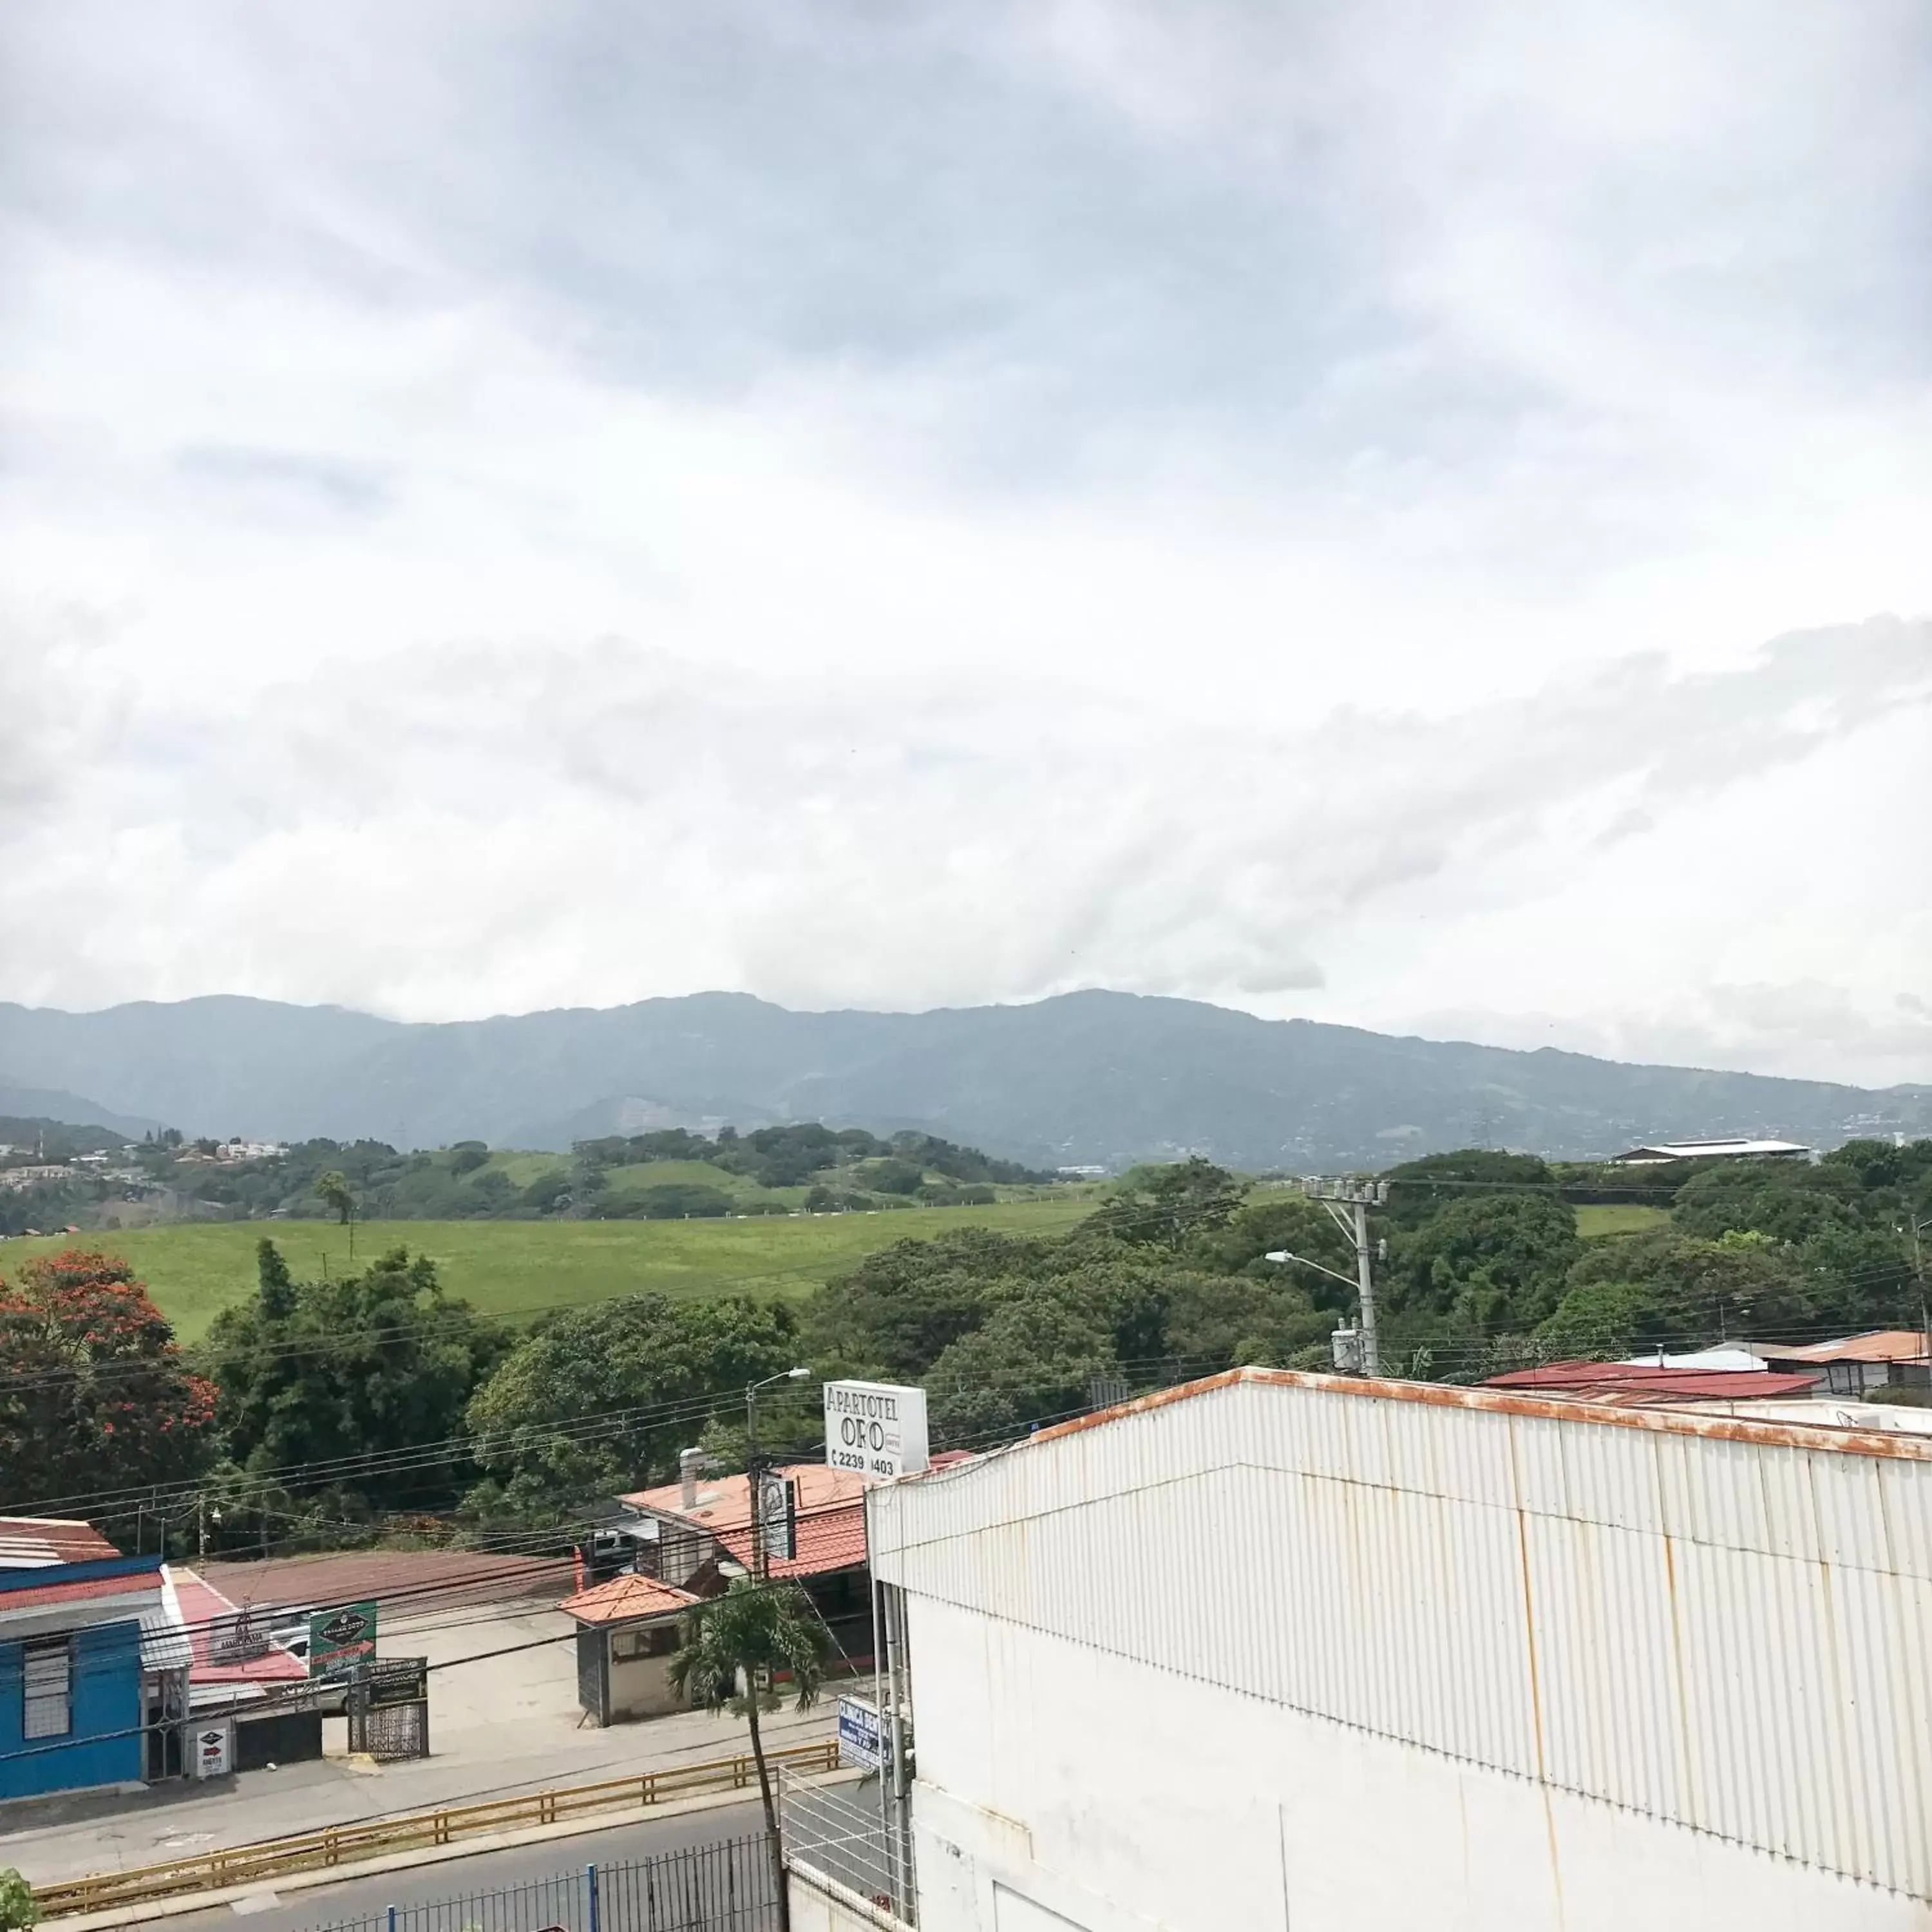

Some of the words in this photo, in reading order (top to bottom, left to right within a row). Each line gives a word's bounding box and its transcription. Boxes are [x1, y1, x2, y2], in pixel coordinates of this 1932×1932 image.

[826, 1387, 898, 1421] APARTOTEL
[841, 1417, 884, 1452] ORO
[839, 1452, 864, 1470] 2239
